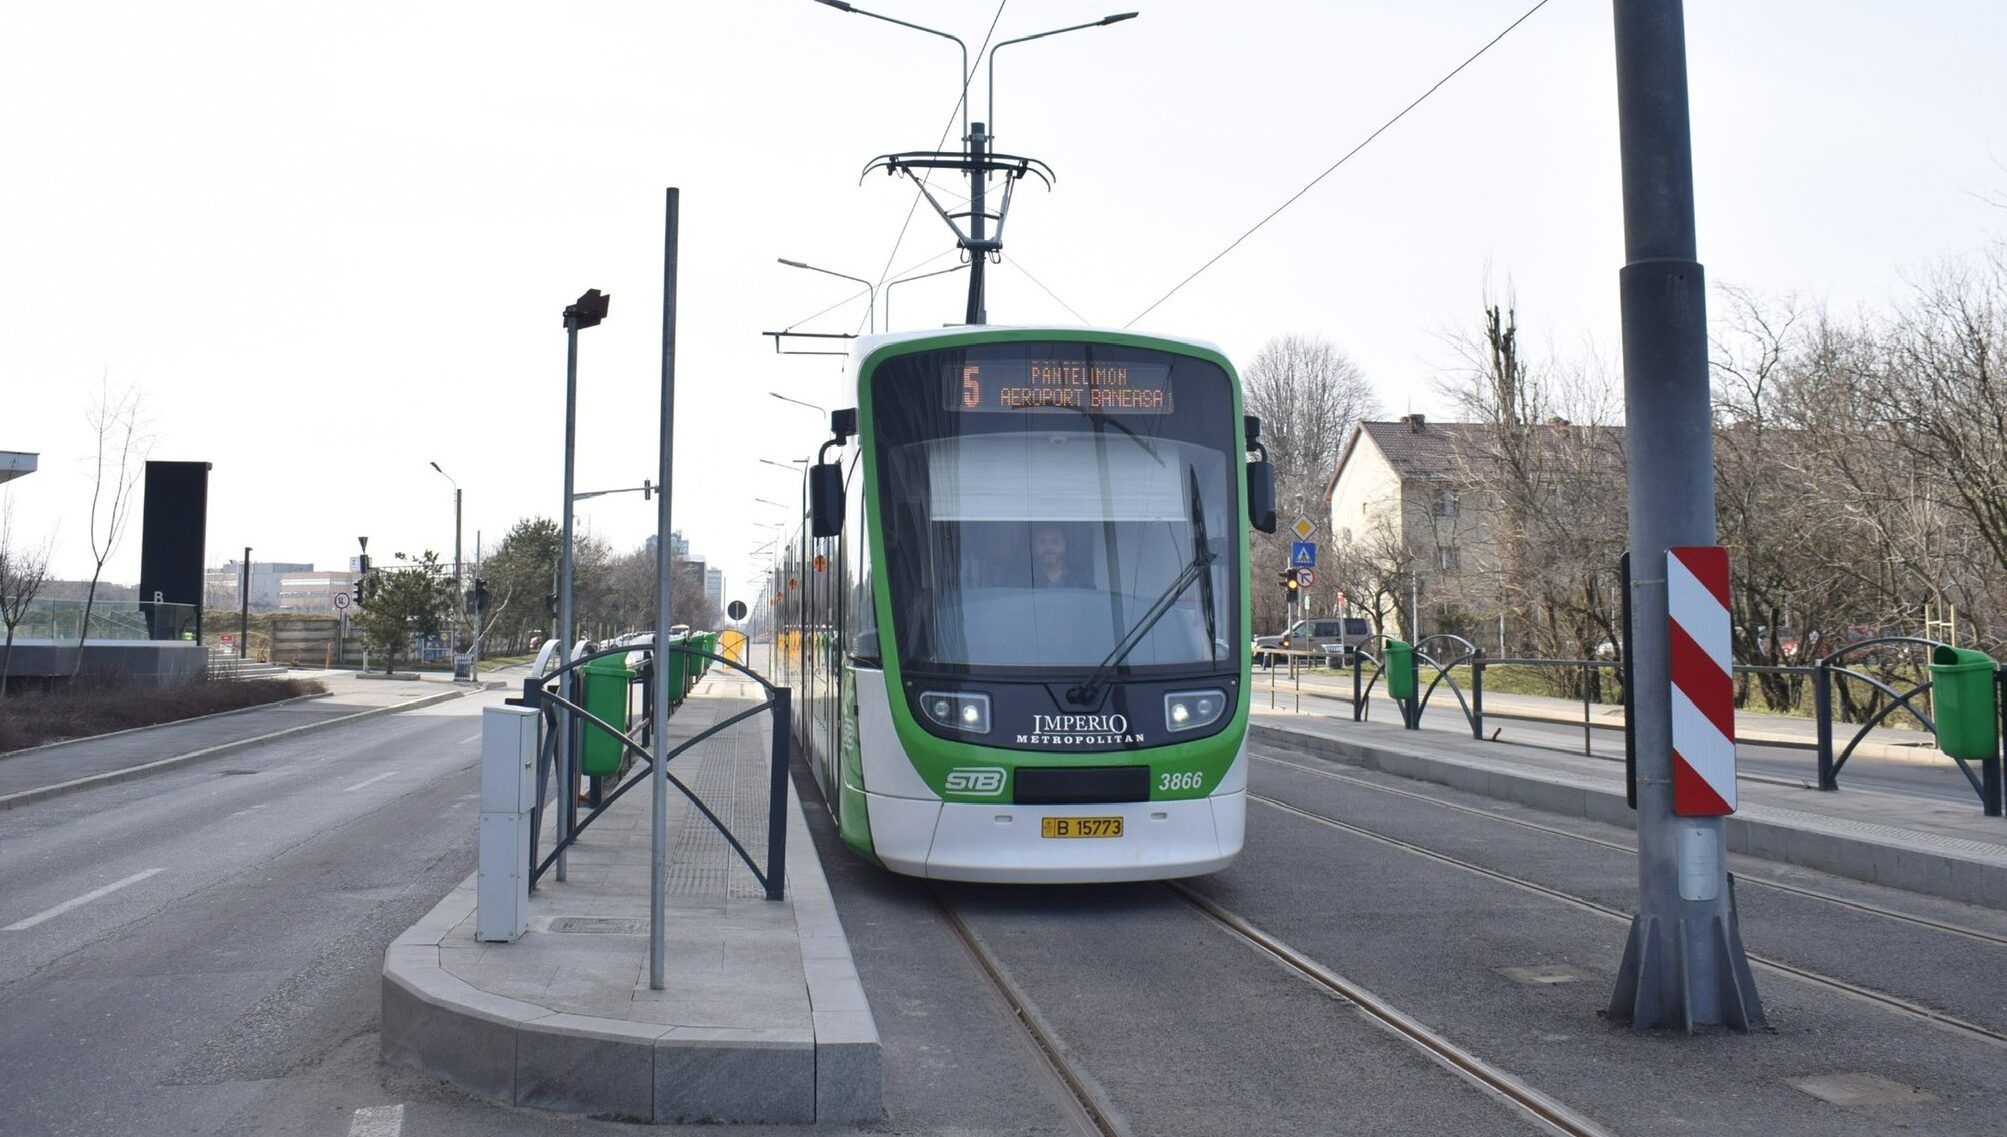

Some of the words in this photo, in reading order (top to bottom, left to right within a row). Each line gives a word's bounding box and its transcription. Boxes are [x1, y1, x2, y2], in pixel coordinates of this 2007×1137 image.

[1031, 367, 1127, 385] PANTELIMON
[963, 366, 980, 408] 5
[1001, 387, 1083, 407] AEROPORT
[1091, 389, 1163, 408] BANEASA
[1033, 714, 1127, 734] IMPERIO
[1016, 733, 1144, 744] METROPOLITAN
[945, 772, 1000, 790] STB
[1159, 772, 1203, 790] 3866
[1057, 820, 1069, 835] B
[1077, 819, 1121, 835] 15773
